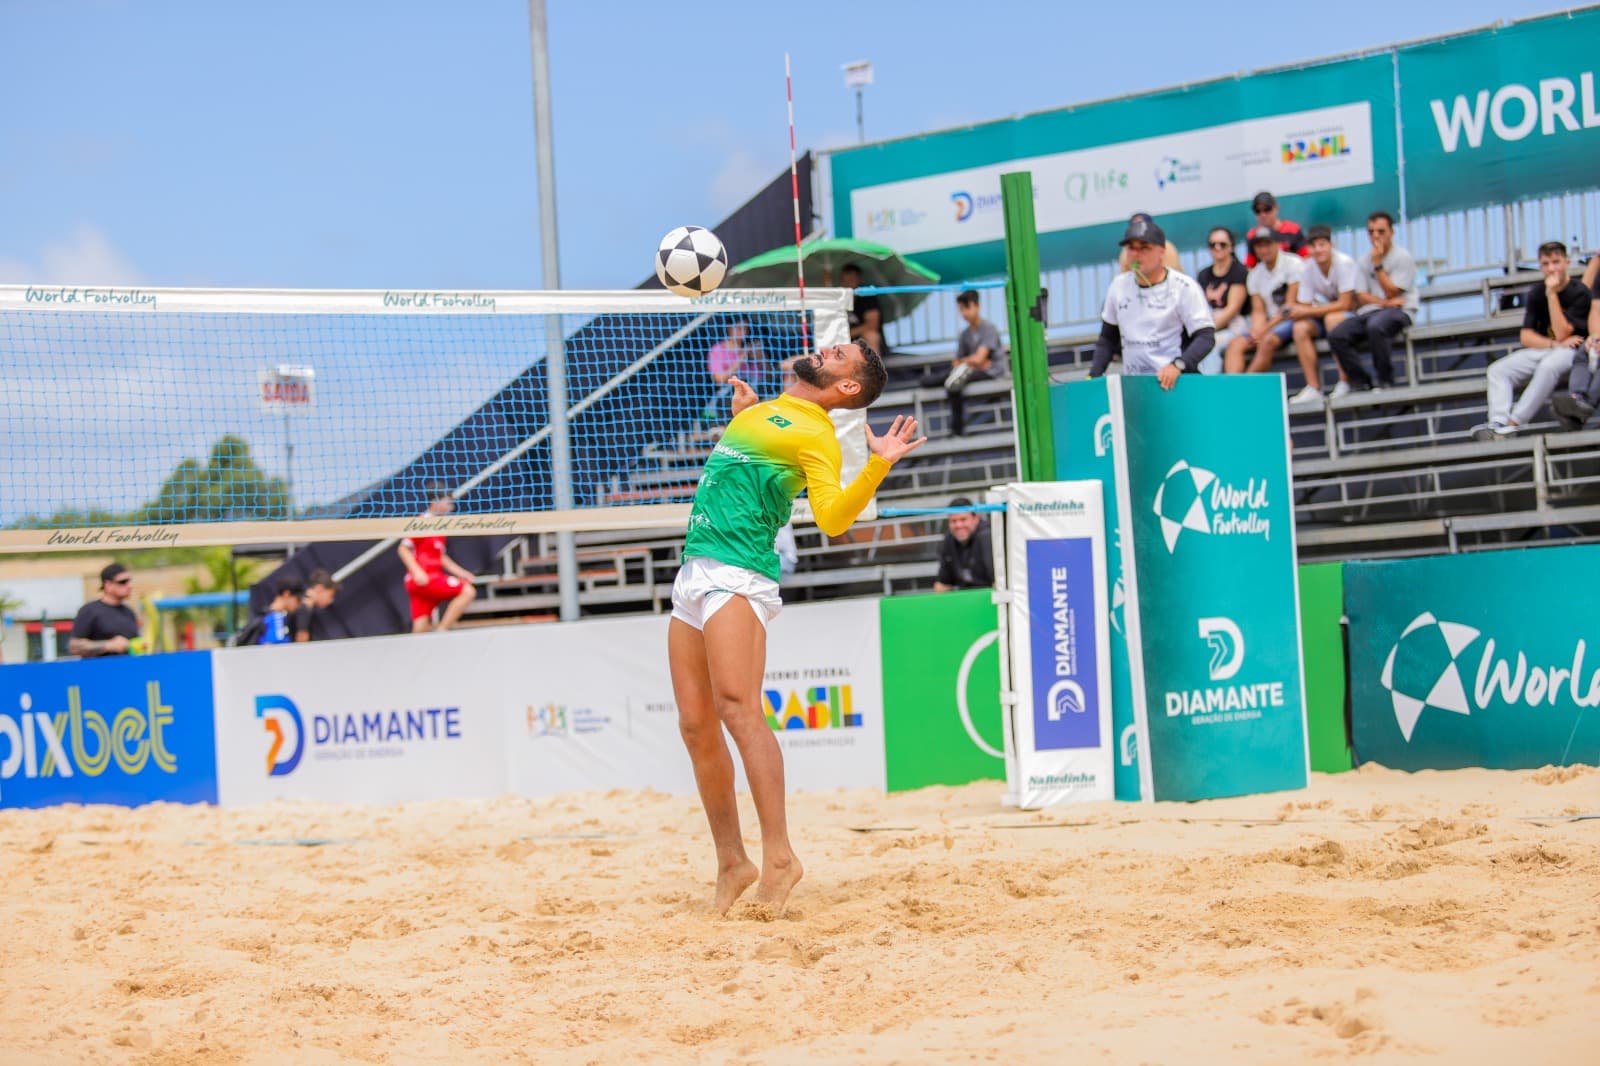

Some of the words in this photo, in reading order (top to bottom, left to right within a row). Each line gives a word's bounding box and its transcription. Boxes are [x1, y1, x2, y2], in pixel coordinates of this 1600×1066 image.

[1281, 133, 1350, 164] BRASIL
[26, 286, 80, 303] World
[83, 289, 157, 310] Footvolley
[384, 291, 430, 307] World
[432, 293, 496, 313] Footvolley
[1211, 477, 1269, 511] World
[47, 530, 104, 545] World
[106, 527, 179, 549] Footvolley
[403, 518, 451, 532] World
[453, 517, 516, 533] Footvolley
[1213, 511, 1270, 542] Footvolley
[1051, 567, 1072, 676] DIAMANTE
[1165, 682, 1284, 717] DIAMANTE
[313, 707, 462, 745] DIAMANTE
